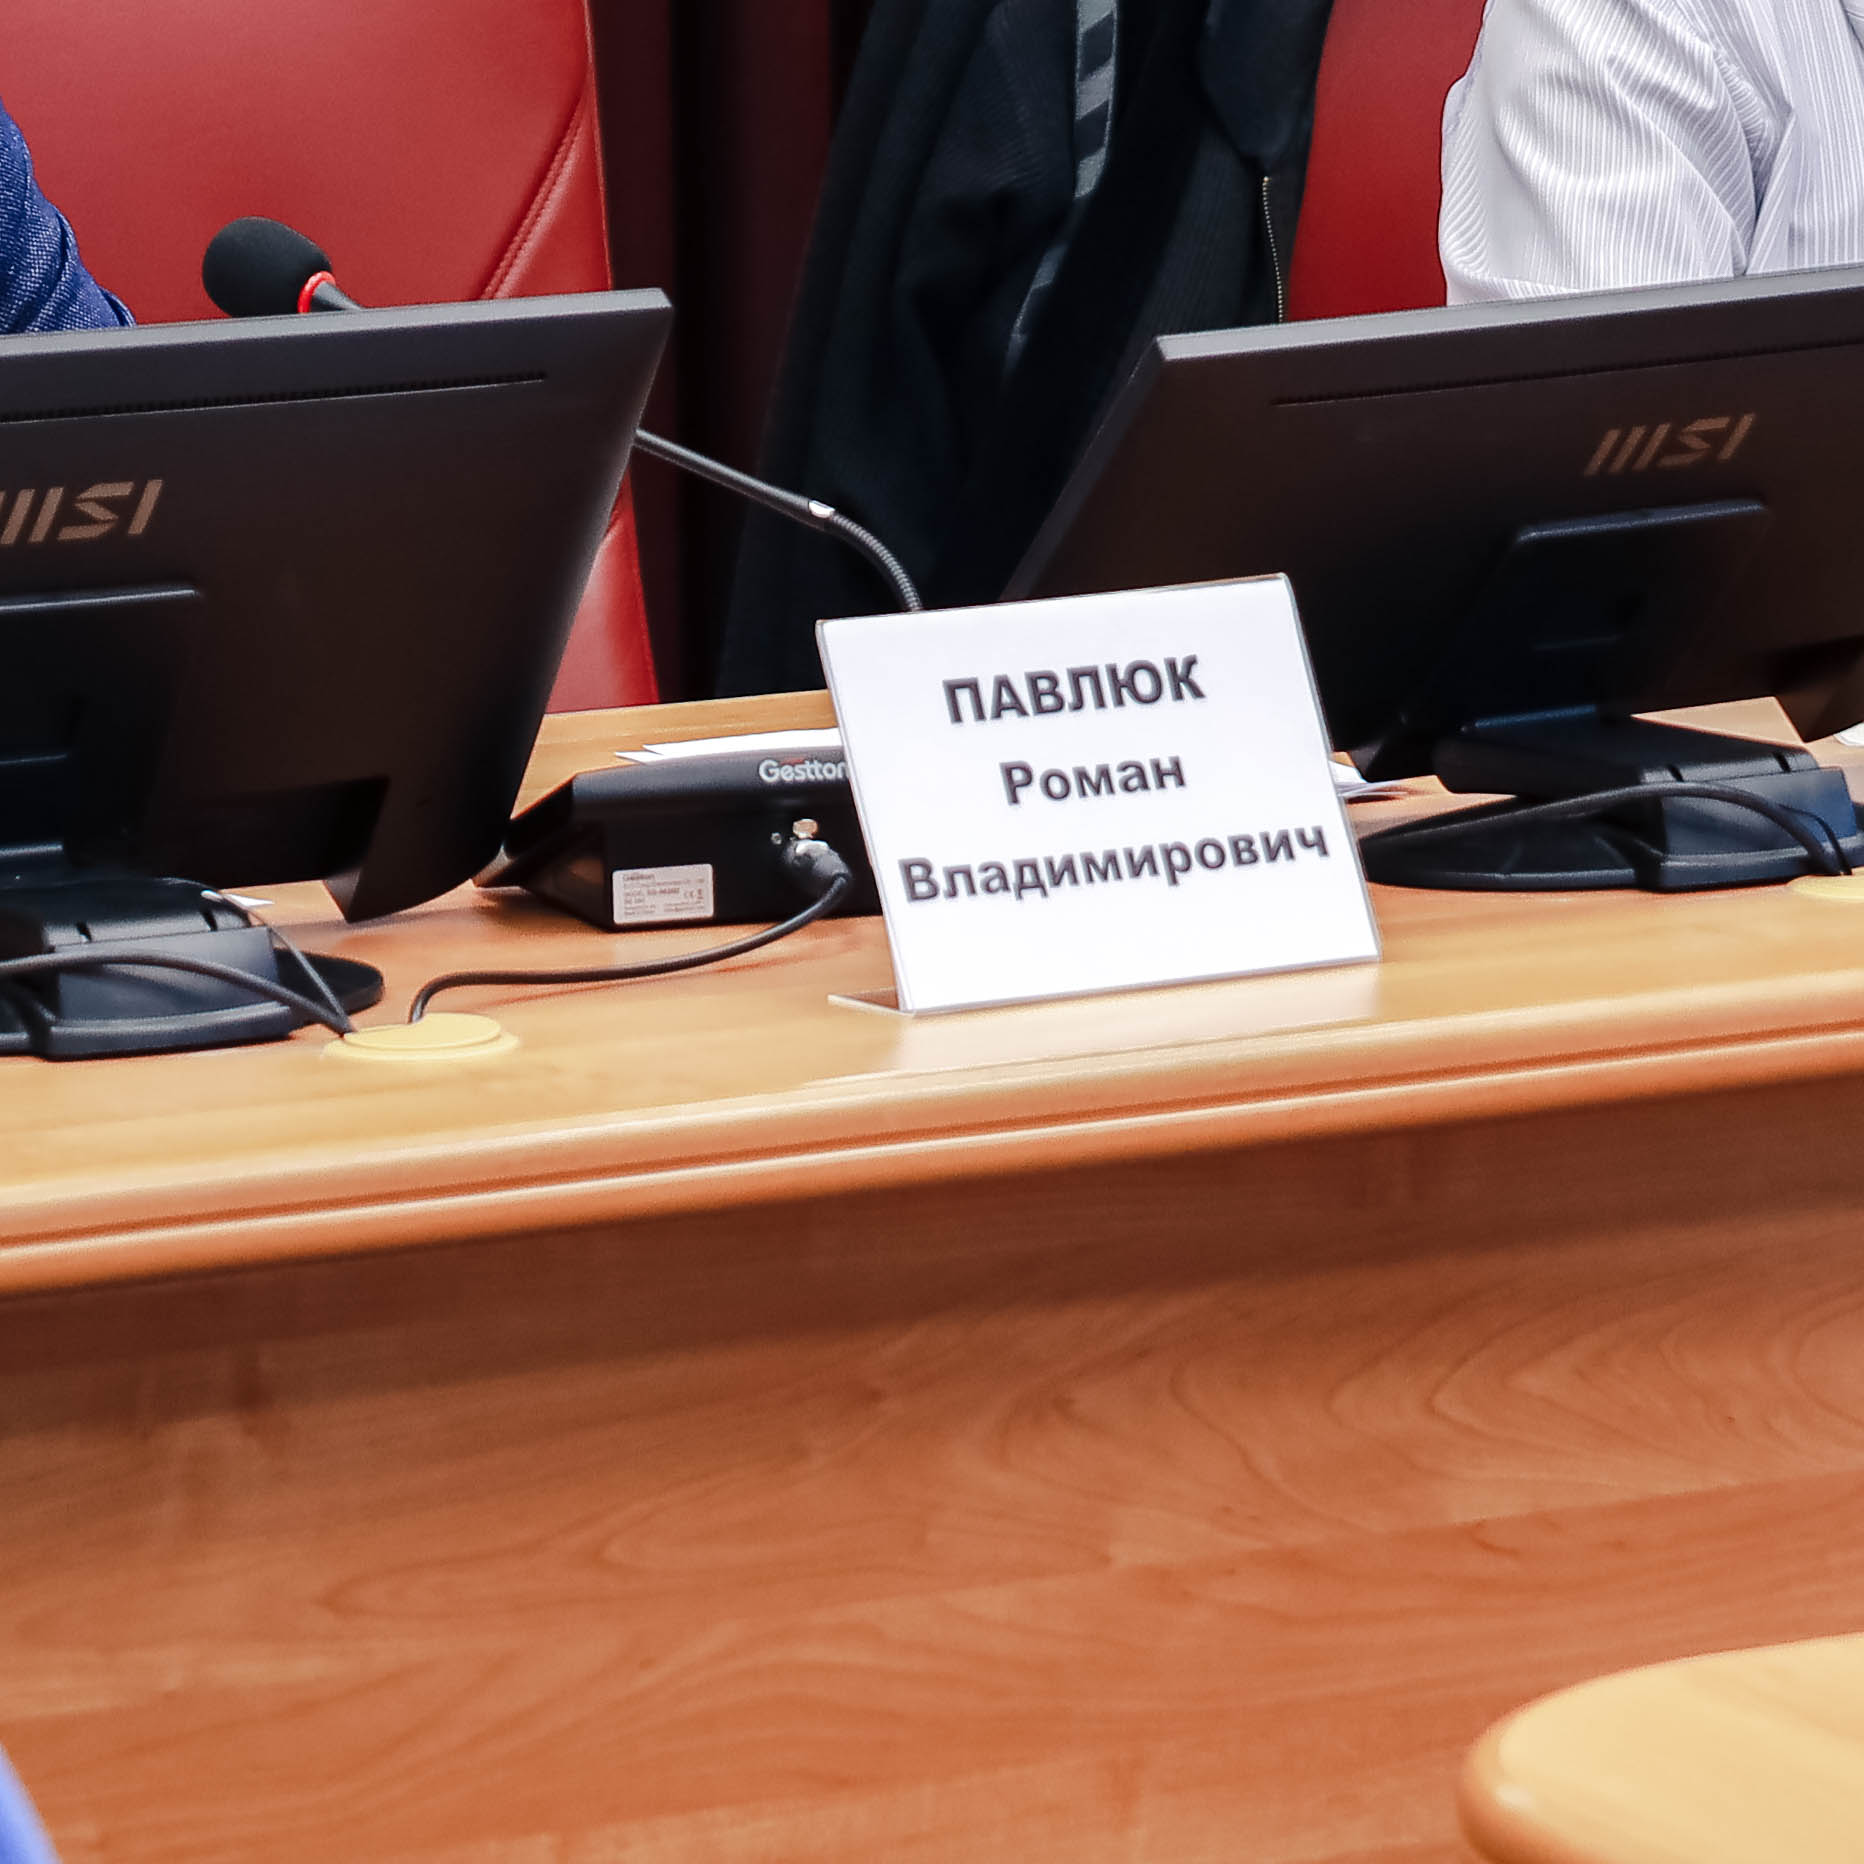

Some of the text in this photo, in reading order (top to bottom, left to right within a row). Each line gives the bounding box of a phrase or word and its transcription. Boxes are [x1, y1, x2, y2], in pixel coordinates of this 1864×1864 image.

[1584, 413, 1755, 476] MSI
[941, 653, 1207, 724] ПАВЛЮК
[999, 755, 1187, 806] Роман
[897, 825, 1331, 903] Владимирович
